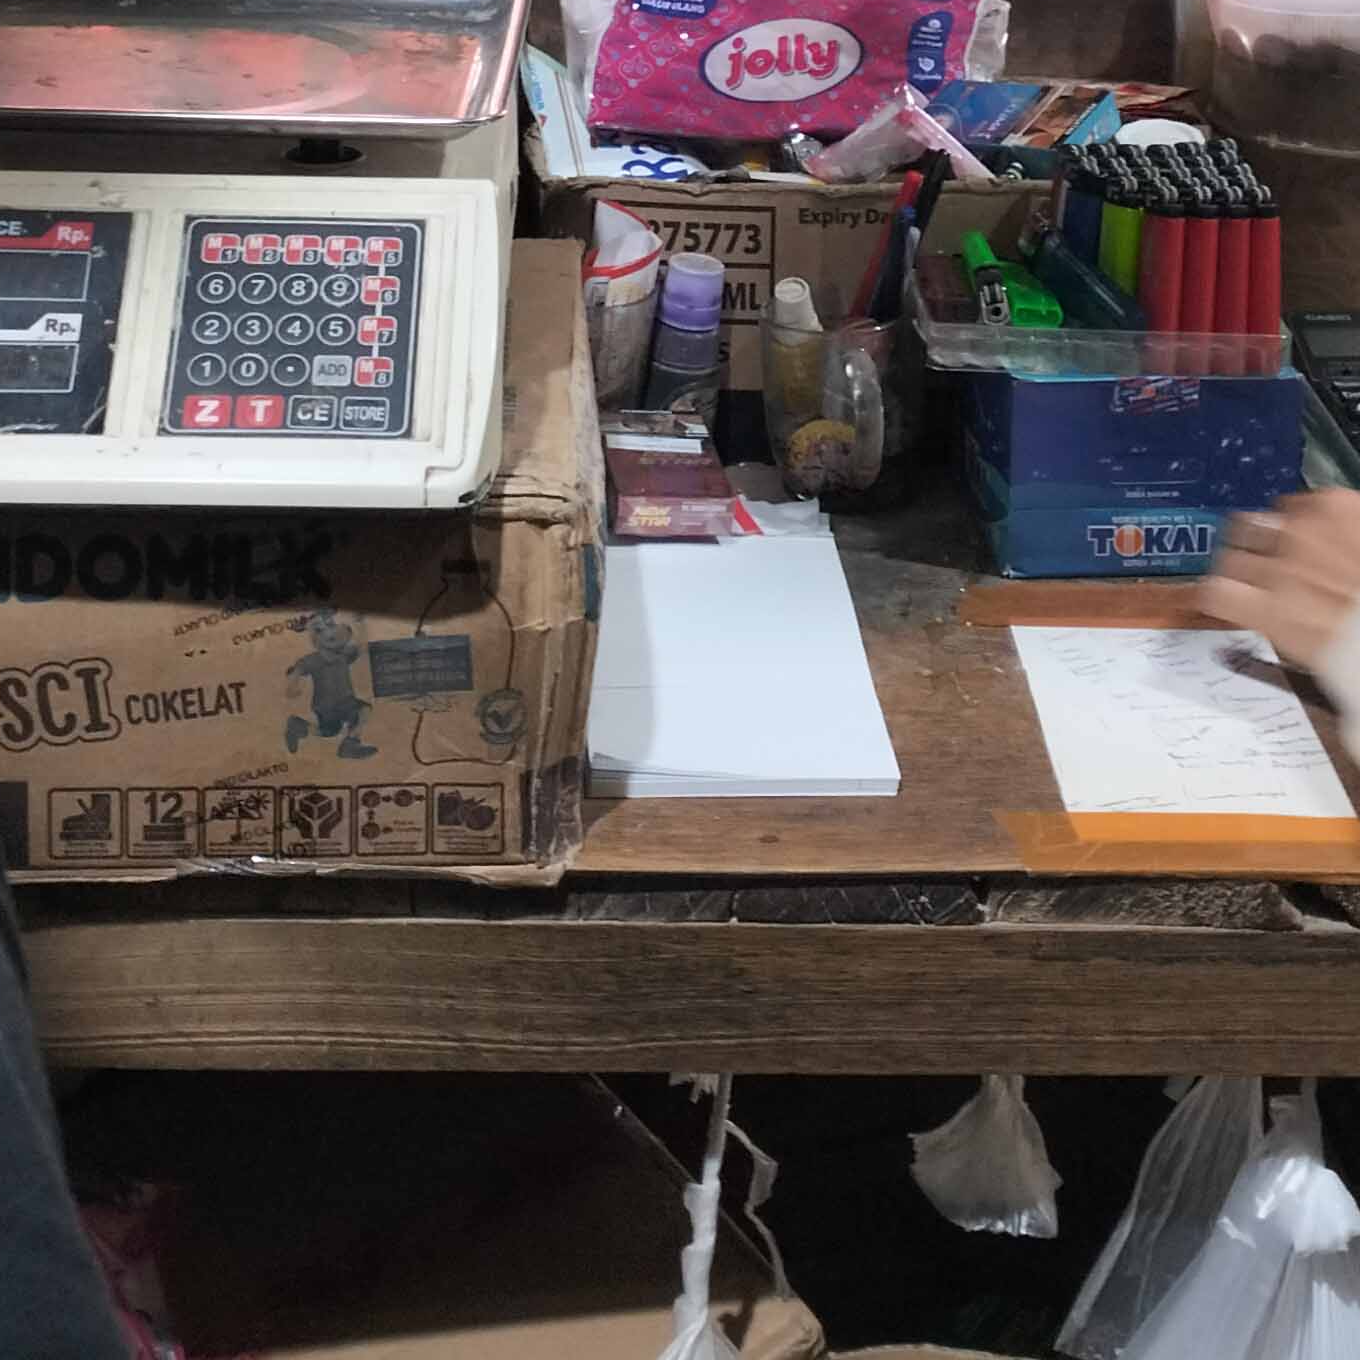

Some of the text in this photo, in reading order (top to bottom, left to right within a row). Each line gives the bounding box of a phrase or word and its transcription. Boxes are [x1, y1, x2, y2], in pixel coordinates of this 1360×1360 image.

[725, 33, 840, 90] jolly
[798, 207, 861, 228] Expiry
[208, 279, 224, 296] 6
[250, 279, 266, 296] 7
[291, 280, 306, 297] 8
[332, 281, 347, 297] 9
[204, 320, 220, 336] 2
[245, 320, 260, 336] 3
[287, 321, 302, 337] 4
[328, 321, 344, 337] 5
[201, 361, 211, 377] 1
[241, 361, 256, 377] 0
[194, 399, 385, 423] Z T CE STORE
[1087, 524, 1217, 557] TOKAI
[125, 681, 247, 725] COKELAT
[143, 791, 184, 824] 12
